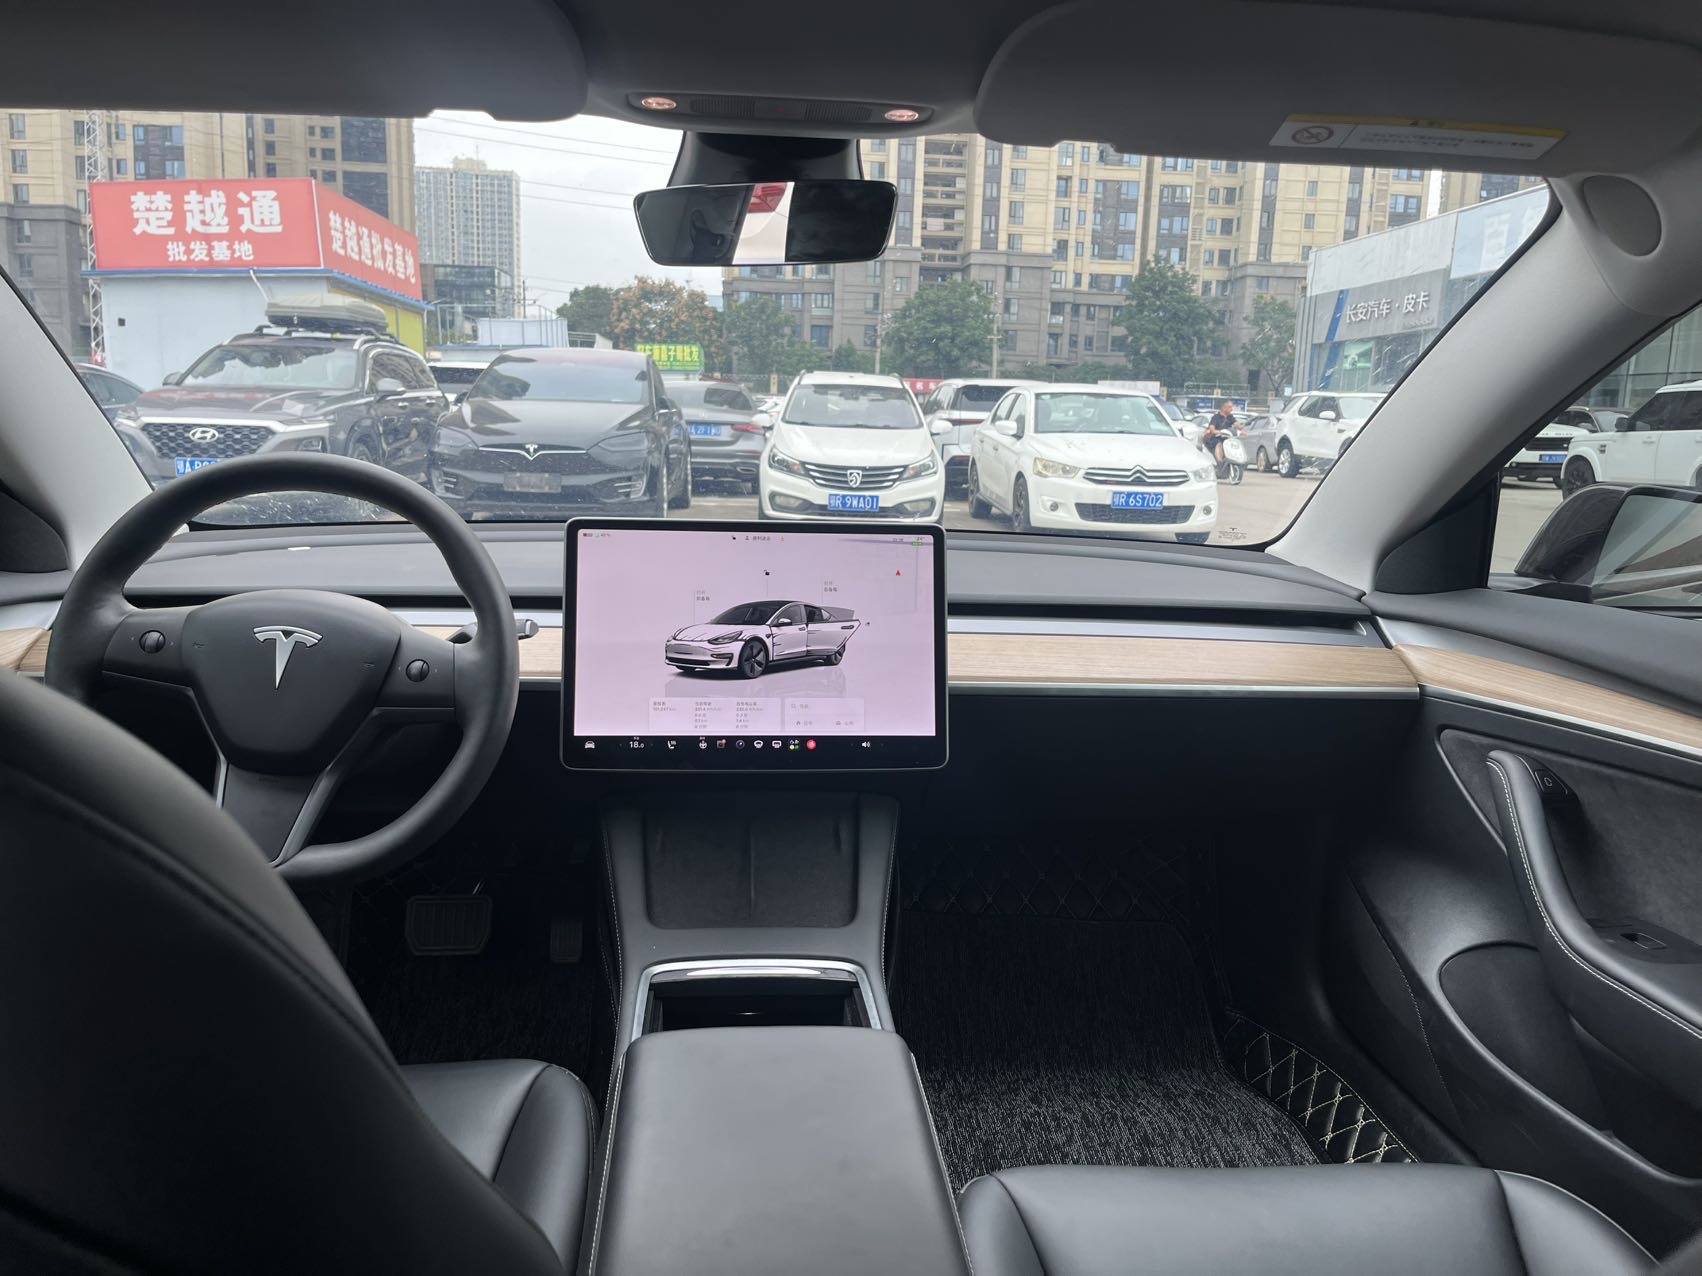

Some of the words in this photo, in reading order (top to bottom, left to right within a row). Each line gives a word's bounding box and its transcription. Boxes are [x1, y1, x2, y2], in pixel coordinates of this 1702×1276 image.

[130, 190, 283, 235] 楚越通
[166, 240, 254, 262] 批发基地
[329, 209, 416, 285] 楚越通批发基地
[629, 740, 645, 749] 18.0
